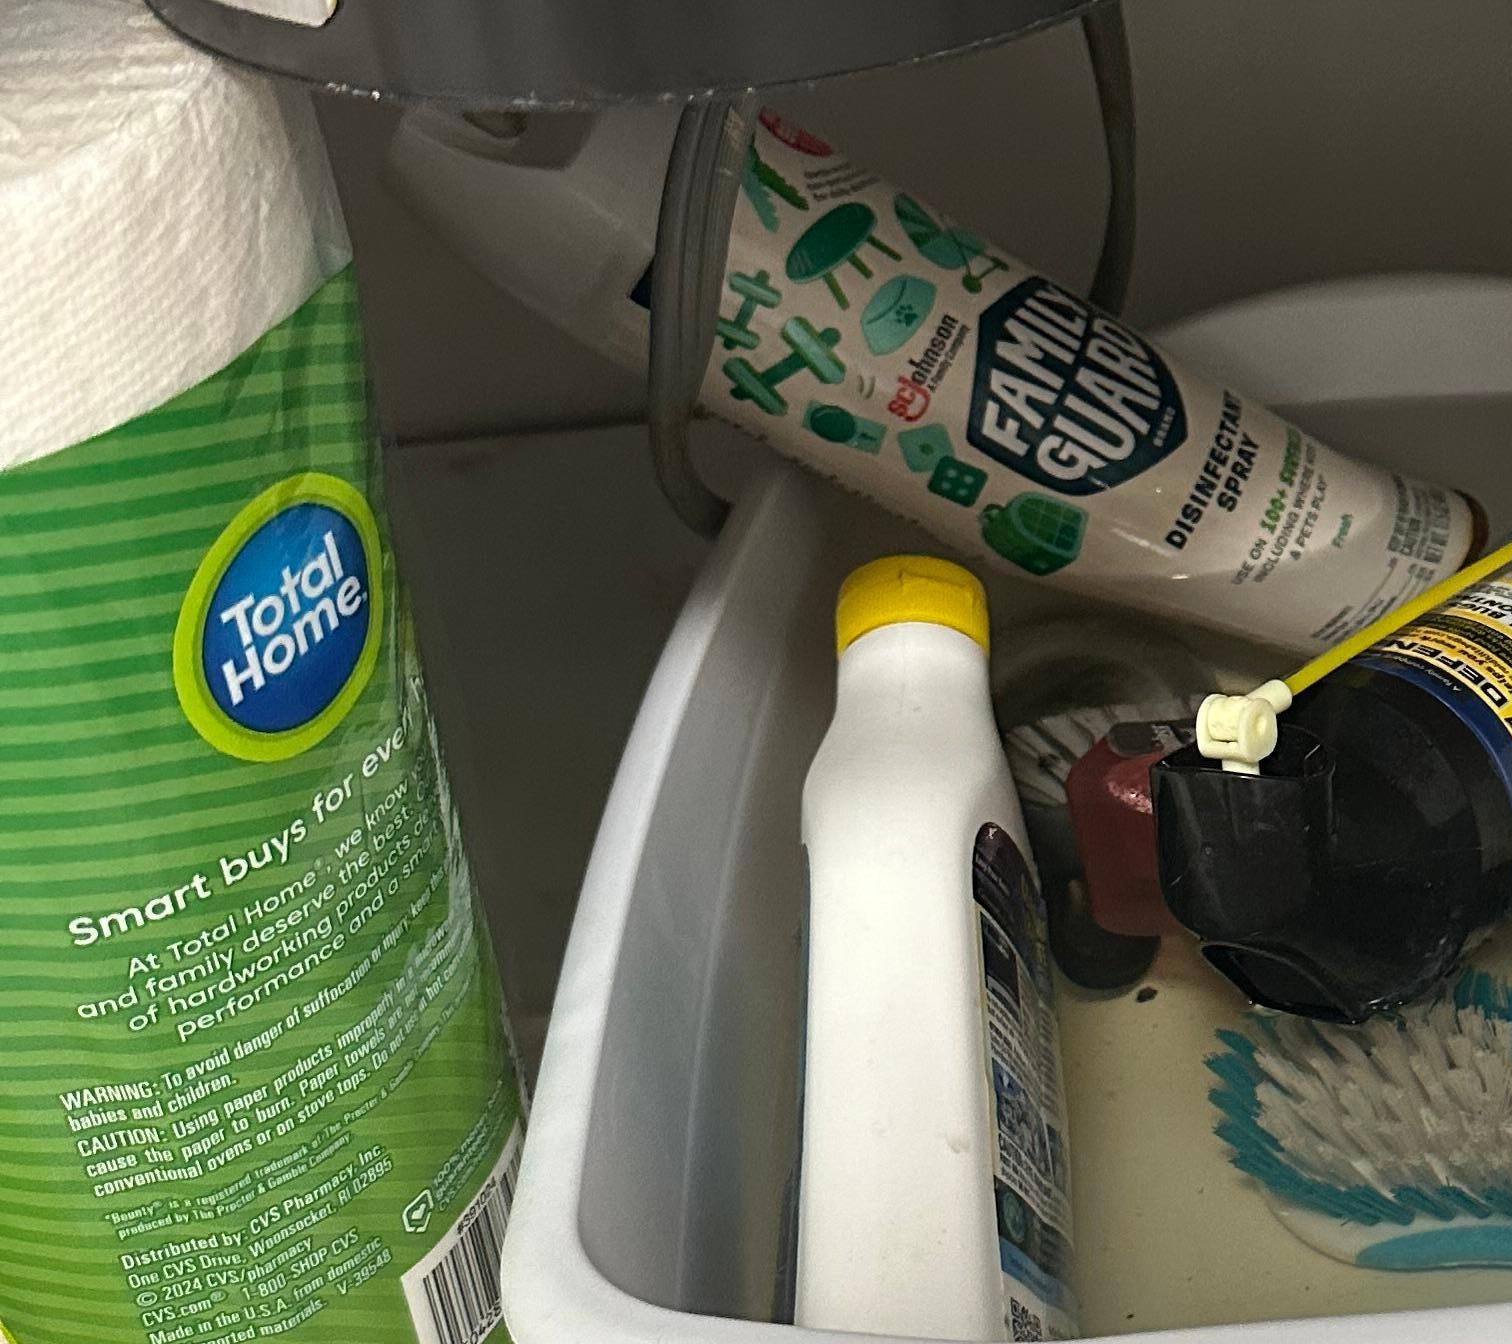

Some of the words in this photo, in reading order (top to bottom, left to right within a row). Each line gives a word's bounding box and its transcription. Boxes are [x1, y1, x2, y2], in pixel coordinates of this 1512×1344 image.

[981, 288, 1090, 457] FAMILY
[1036, 317, 1163, 481] GUARD
[1216, 432, 1260, 513] SPRAY
[1259, 488, 1288, 535] 100+
[1232, 560, 1255, 585] USE
[1250, 537, 1269, 561] ON
[1253, 510, 1300, 584] INCLUDING
[1296, 511, 1319, 548] PETS
[219, 529, 345, 648] Total
[1458, 648, 1485, 666] you
[68, 873, 213, 947] Smart
[219, 817, 309, 887] buys
[311, 772, 355, 824] for
[129, 953, 161, 979] At
[166, 914, 238, 963] Total
[333, 828, 363, 860] we
[364, 778, 409, 832] know
[77, 984, 139, 1020] and
[145, 947, 234, 998] family
[242, 882, 336, 954] deserve
[338, 849, 371, 886] the
[372, 805, 415, 854] best.
[128, 1003, 159, 1032] of
[167, 914, 333, 1016] hardworking
[335, 832, 412, 925] products
[177, 931, 347, 1044] performance
[348, 888, 385, 935] and
[59, 1080, 161, 1113] WARNING:
[161, 1070, 183, 1092] To
[184, 1047, 232, 1081] avoid
[233, 1021, 285, 1062] danger
[286, 1007, 302, 1029] of
[302, 958, 372, 1019] suffocation
[76, 1127, 169, 1158] CAUTION:
[171, 1109, 220, 1139] Using
[223, 1085, 268, 1118] paper
[273, 1042, 334, 1096] products
[335, 989, 394, 1051] improperly
[68, 1107, 128, 1133] babies
[131, 1100, 164, 1121] and
[167, 1072, 238, 1113] children.
[86, 1152, 139, 1178] cause
[144, 1147, 175, 1164] the
[180, 1127, 226, 1164] paper
[231, 1114, 250, 1135] to
[255, 1094, 297, 1125] burn.
[299, 1061, 341, 1098] Paper
[344, 1024, 387, 1068] towels
[92, 1159, 204, 1199] conventional
[207, 1136, 253, 1173] ovens
[255, 1128, 273, 1146] or
[276, 1115, 296, 1136] on
[296, 1092, 336, 1124] stove
[335, 1066, 372, 1098] tops.
[370, 1046, 389, 1071] Do
[117, 1216, 172, 1242] produced
[193, 1209, 215, 1222] The
[267, 1163, 309, 1190] Gamble
[120, 1232, 219, 1272] Distributed
[222, 1230, 249, 1253] by:
[249, 1205, 282, 1236] CVS
[282, 1164, 359, 1217] Pharmacy,
[358, 1144, 386, 1166] Inc.
[127, 1270, 161, 1290] One
[162, 1257, 198, 1280] CVS
[248, 1202, 338, 1259] Woonsocket,
[336, 1186, 352, 1207] RI
[351, 1156, 394, 1195] 02895
[195, 1174, 252, 1208] registered
[254, 1145, 310, 1179] trademark
[161, 1278, 203, 1302] 2024
[205, 1235, 313, 1290] CVS/pharmacy
[197, 1319, 213, 1335] in
[213, 1309, 242, 1330] the
[243, 1297, 292, 1322] U.S.A.
[291, 1274, 325, 1304] from
[325, 1235, 383, 1282] domestic
[330, 1227, 360, 1257] CVS
[335, 1246, 394, 1297] V-39548
[258, 1297, 328, 1338] materials.
